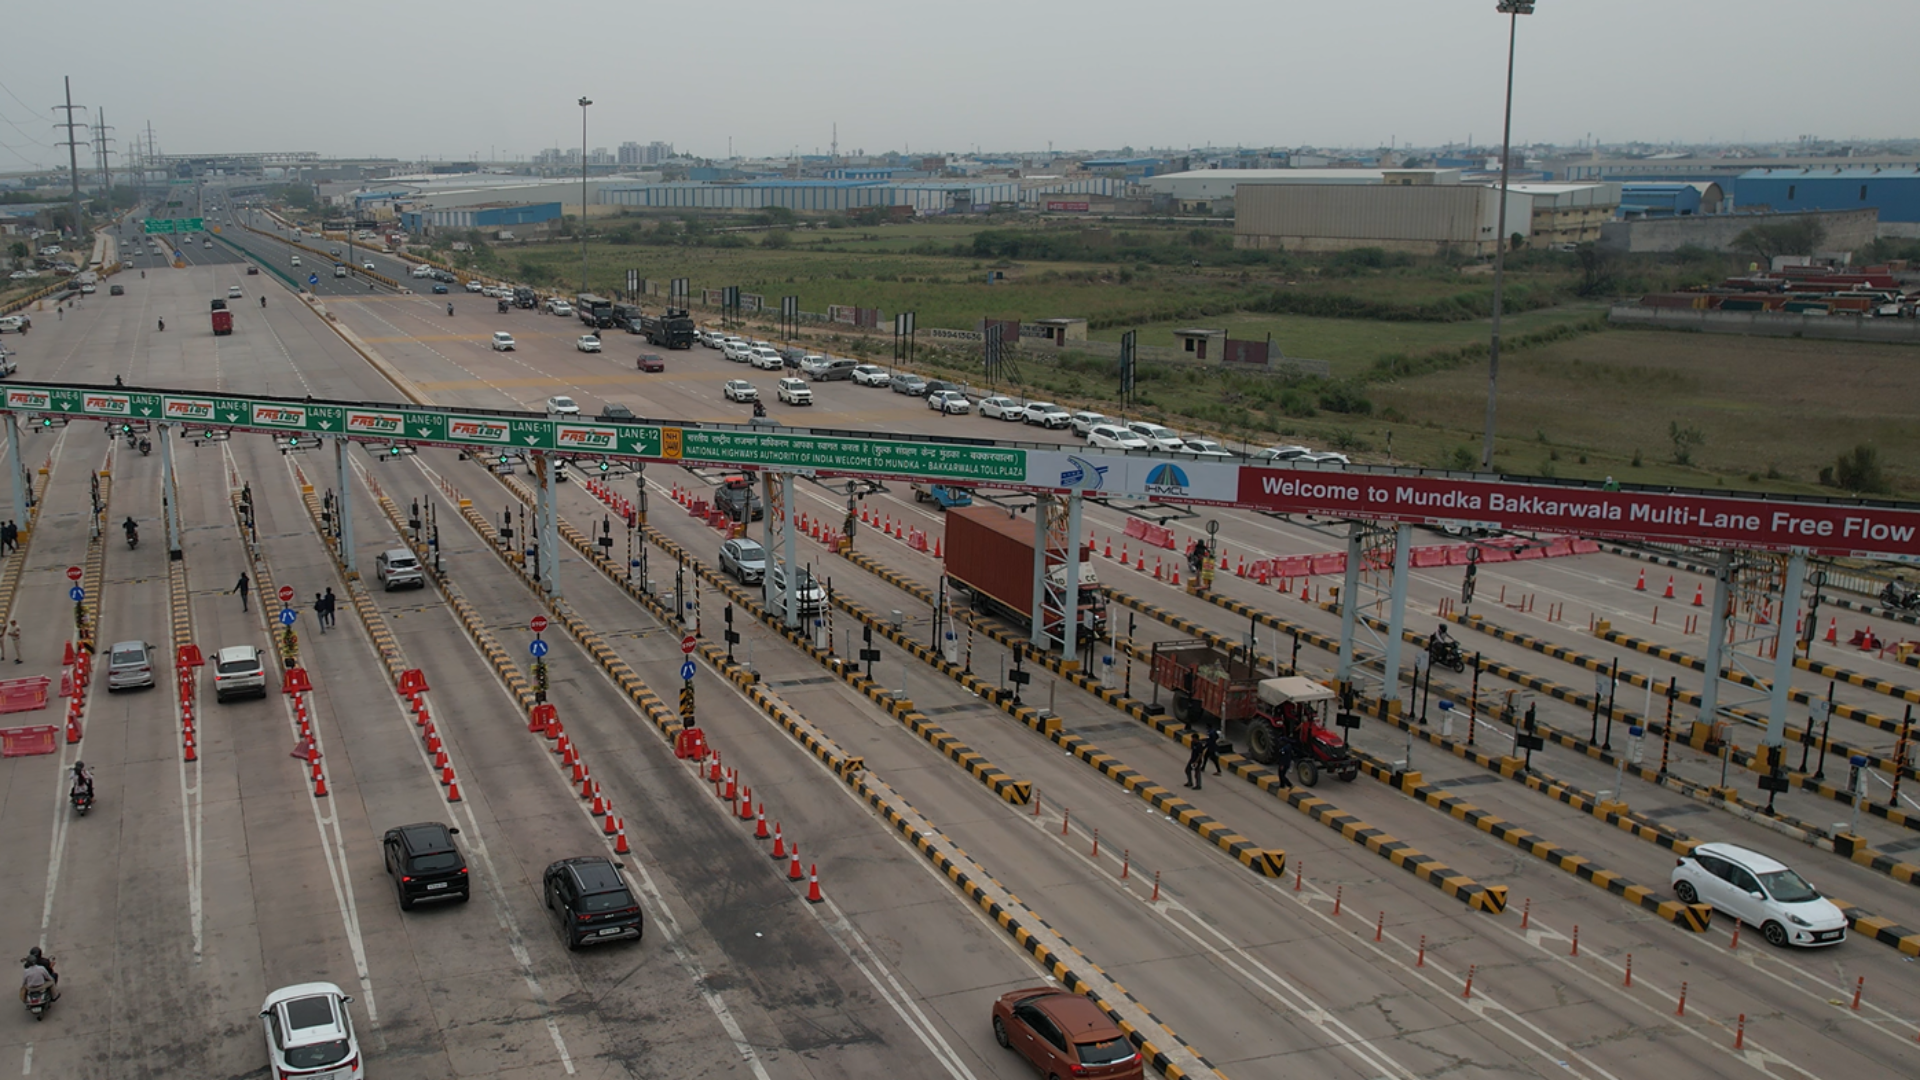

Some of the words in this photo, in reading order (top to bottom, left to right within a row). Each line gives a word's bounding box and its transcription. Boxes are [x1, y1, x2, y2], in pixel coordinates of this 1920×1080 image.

[51, 390, 78, 400] LANE-6
[132, 396, 160, 407] LANE-7
[216, 400, 248, 412] LANE-8
[308, 407, 342, 419] LANE-9
[406, 414, 442, 426] LANE-10
[512, 421, 550, 434] LANE-11
[619, 428, 658, 440] LANE-12
[687, 432, 709, 442] भारतीय
[712, 434, 730, 445] राष्ट्रीय
[734, 434, 758, 445] राजमार्ग
[760, 436, 789, 448] प्राधिकरण
[793, 440, 814, 450] आपका
[817, 442, 838, 450] स्वागत
[841, 443, 859, 451] करता
[863, 443, 868, 452] है
[686, 446, 720, 456] NATIONAL
[722, 448, 758, 459] HIGHWAYS
[760, 451, 799, 462] AUTHORITY
[800, 454, 810, 462] OF
[812, 454, 833, 464] INDIA
[835, 456, 872, 466] WELCOME
[874, 458, 883, 467] TO
[885, 459, 920, 469] MUNDKA
[928, 462, 979, 474] BAKKARWALA
[981, 465, 998, 475] TOLL
[1000, 466, 1023, 476] PLAZA
[1145, 484, 1189, 496] IHMCL
[1262, 477, 1359, 500] Welcome
[1368, 486, 1388, 503] to
[1396, 487, 1482, 510] Mundka
[1489, 493, 1622, 520] Bakkarwala
[1630, 502, 1760, 531] Multi-Lane
[1772, 512, 1834, 536] Free
[1844, 517, 1915, 542] Flow
